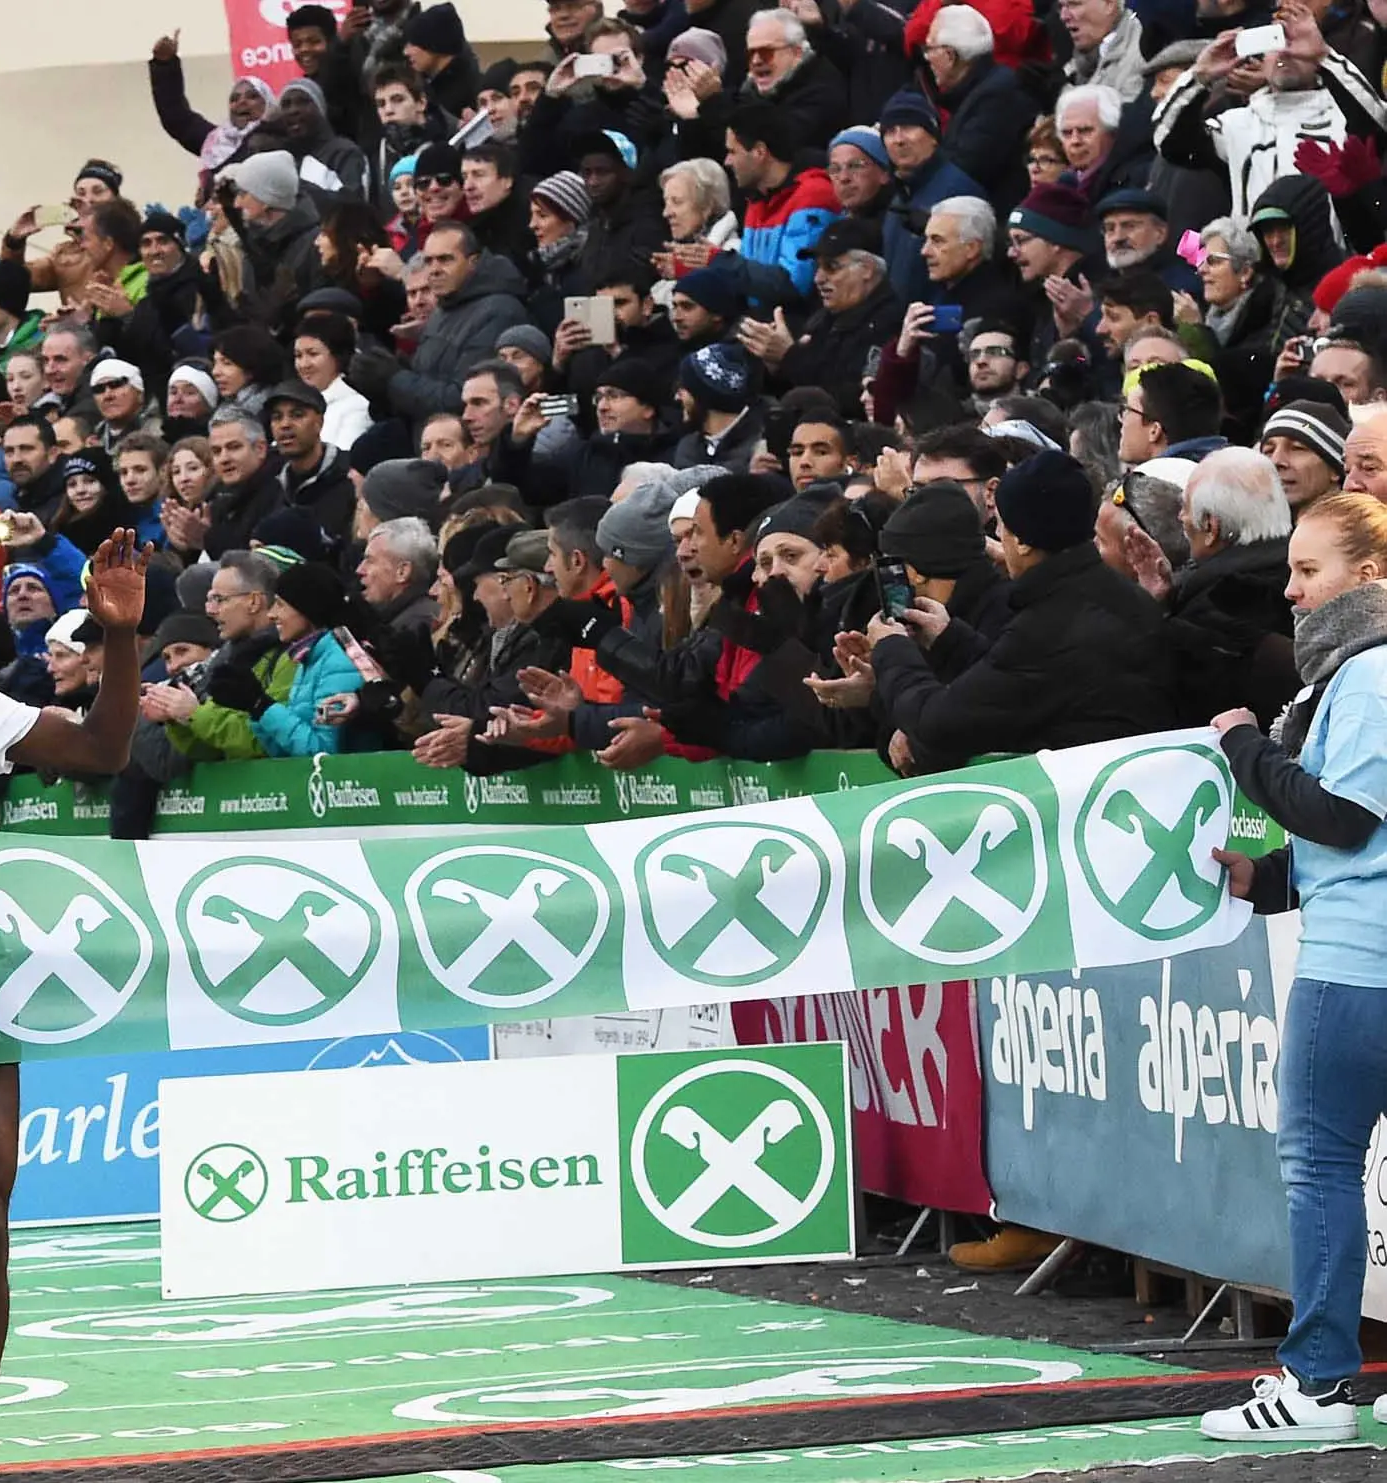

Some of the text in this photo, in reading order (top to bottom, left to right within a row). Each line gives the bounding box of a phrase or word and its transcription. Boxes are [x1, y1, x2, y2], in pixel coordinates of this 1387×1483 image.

[991, 968, 1107, 1132] alperia
[1138, 958, 1280, 1164] alperia
[284, 1145, 604, 1203] Raiffeisen
[605, 1421, 1201, 1470] BOclassic
